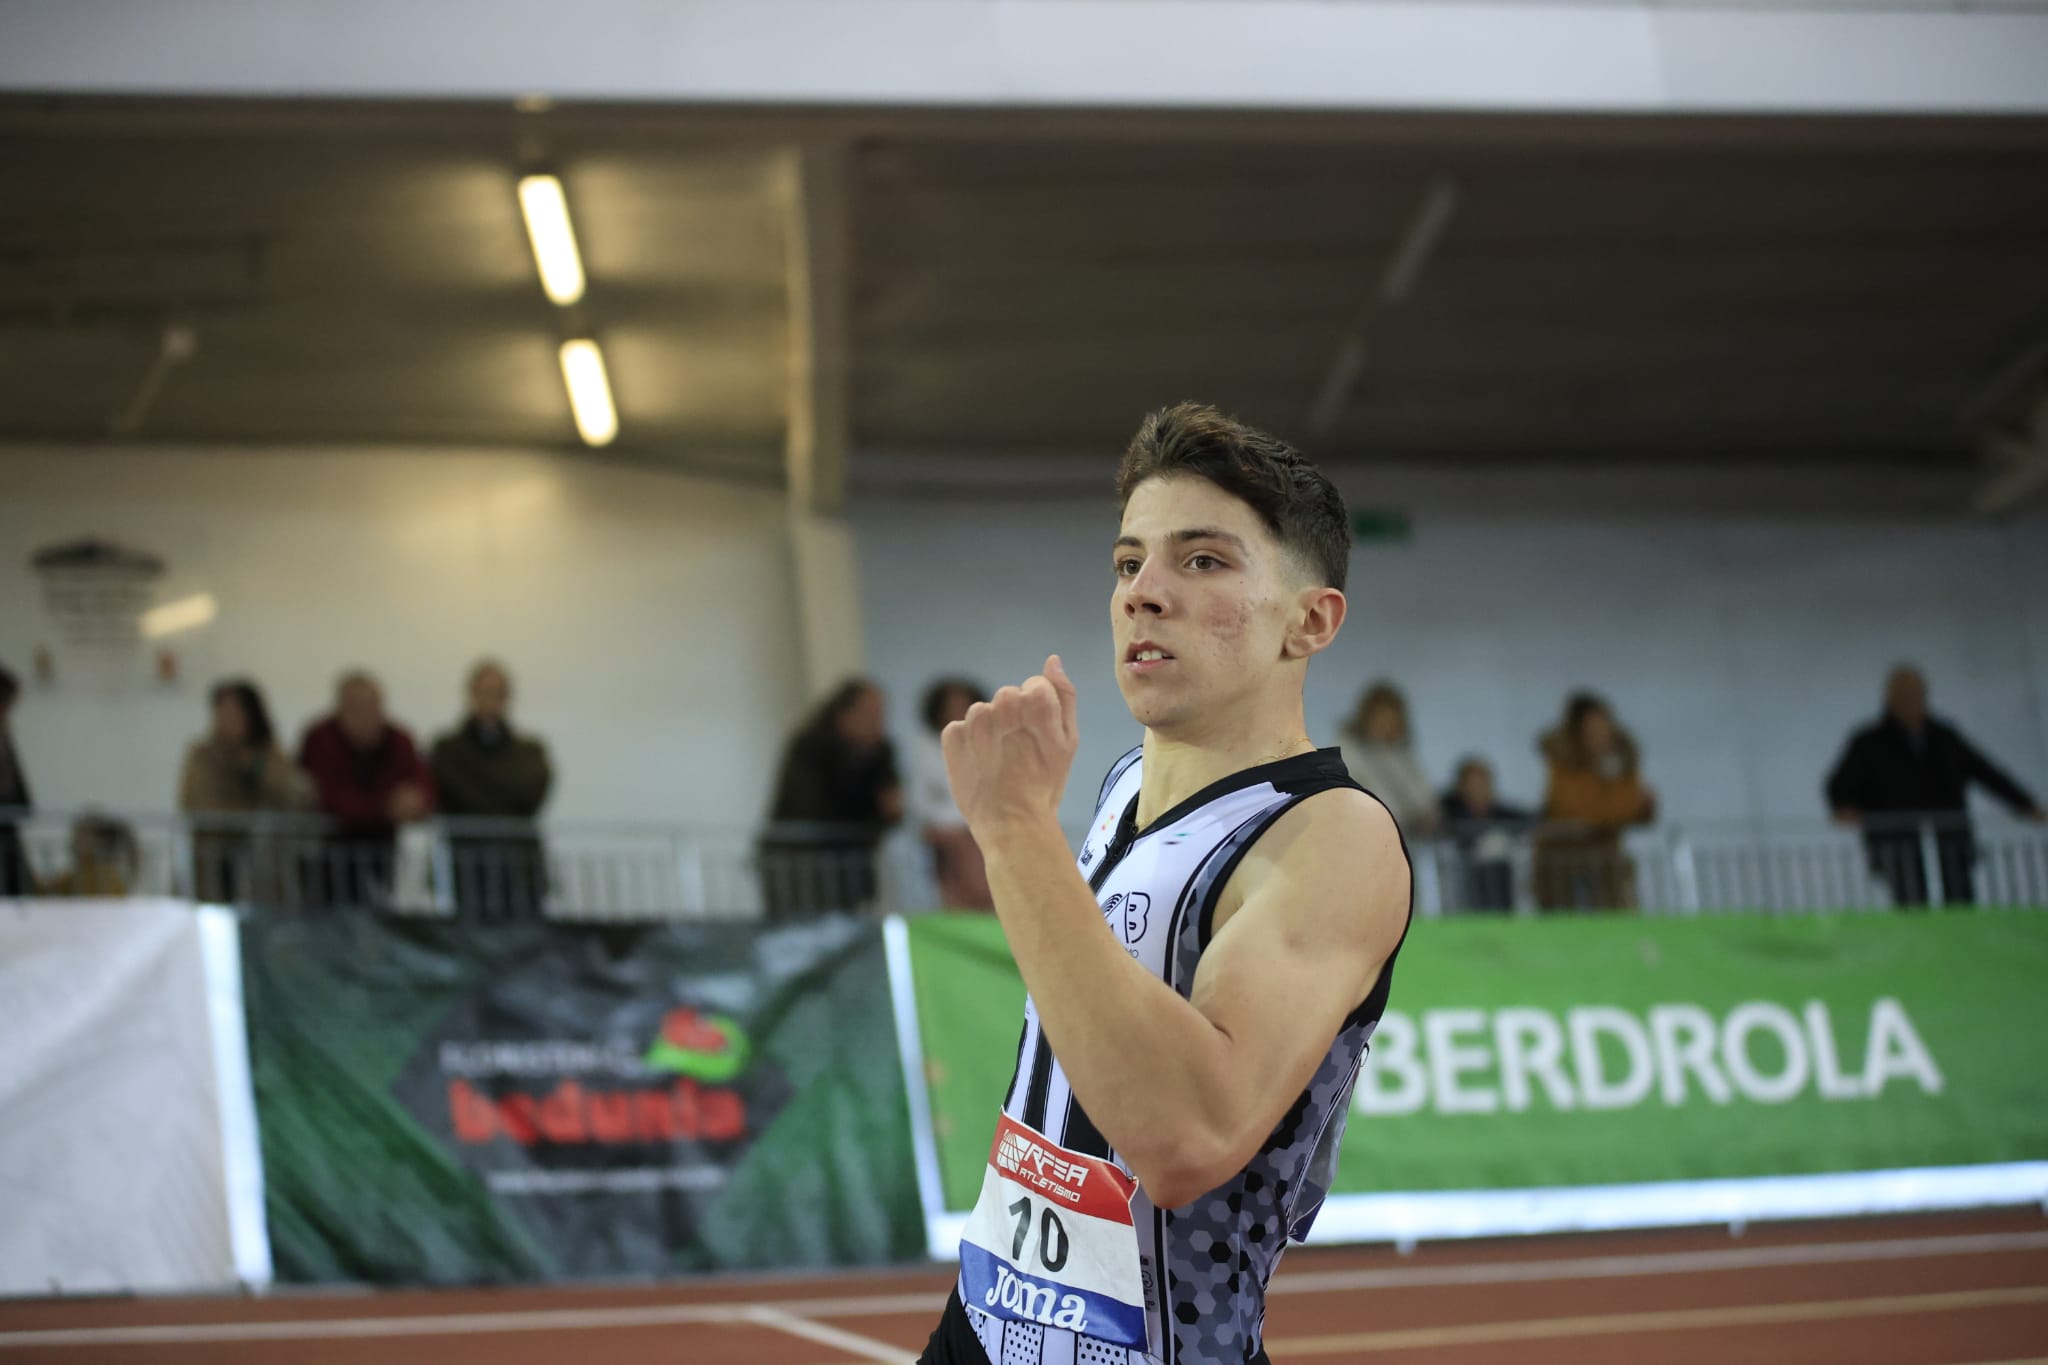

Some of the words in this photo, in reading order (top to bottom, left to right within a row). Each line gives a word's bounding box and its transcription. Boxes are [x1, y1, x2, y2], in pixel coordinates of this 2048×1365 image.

[1357, 997, 1943, 1115] BERDROLA
[1019, 1167, 1081, 1203] ATLETISMO
[1023, 1143, 1089, 1187] RFEA
[1009, 1196, 1069, 1273] 10
[985, 1265, 1088, 1332] Joma
